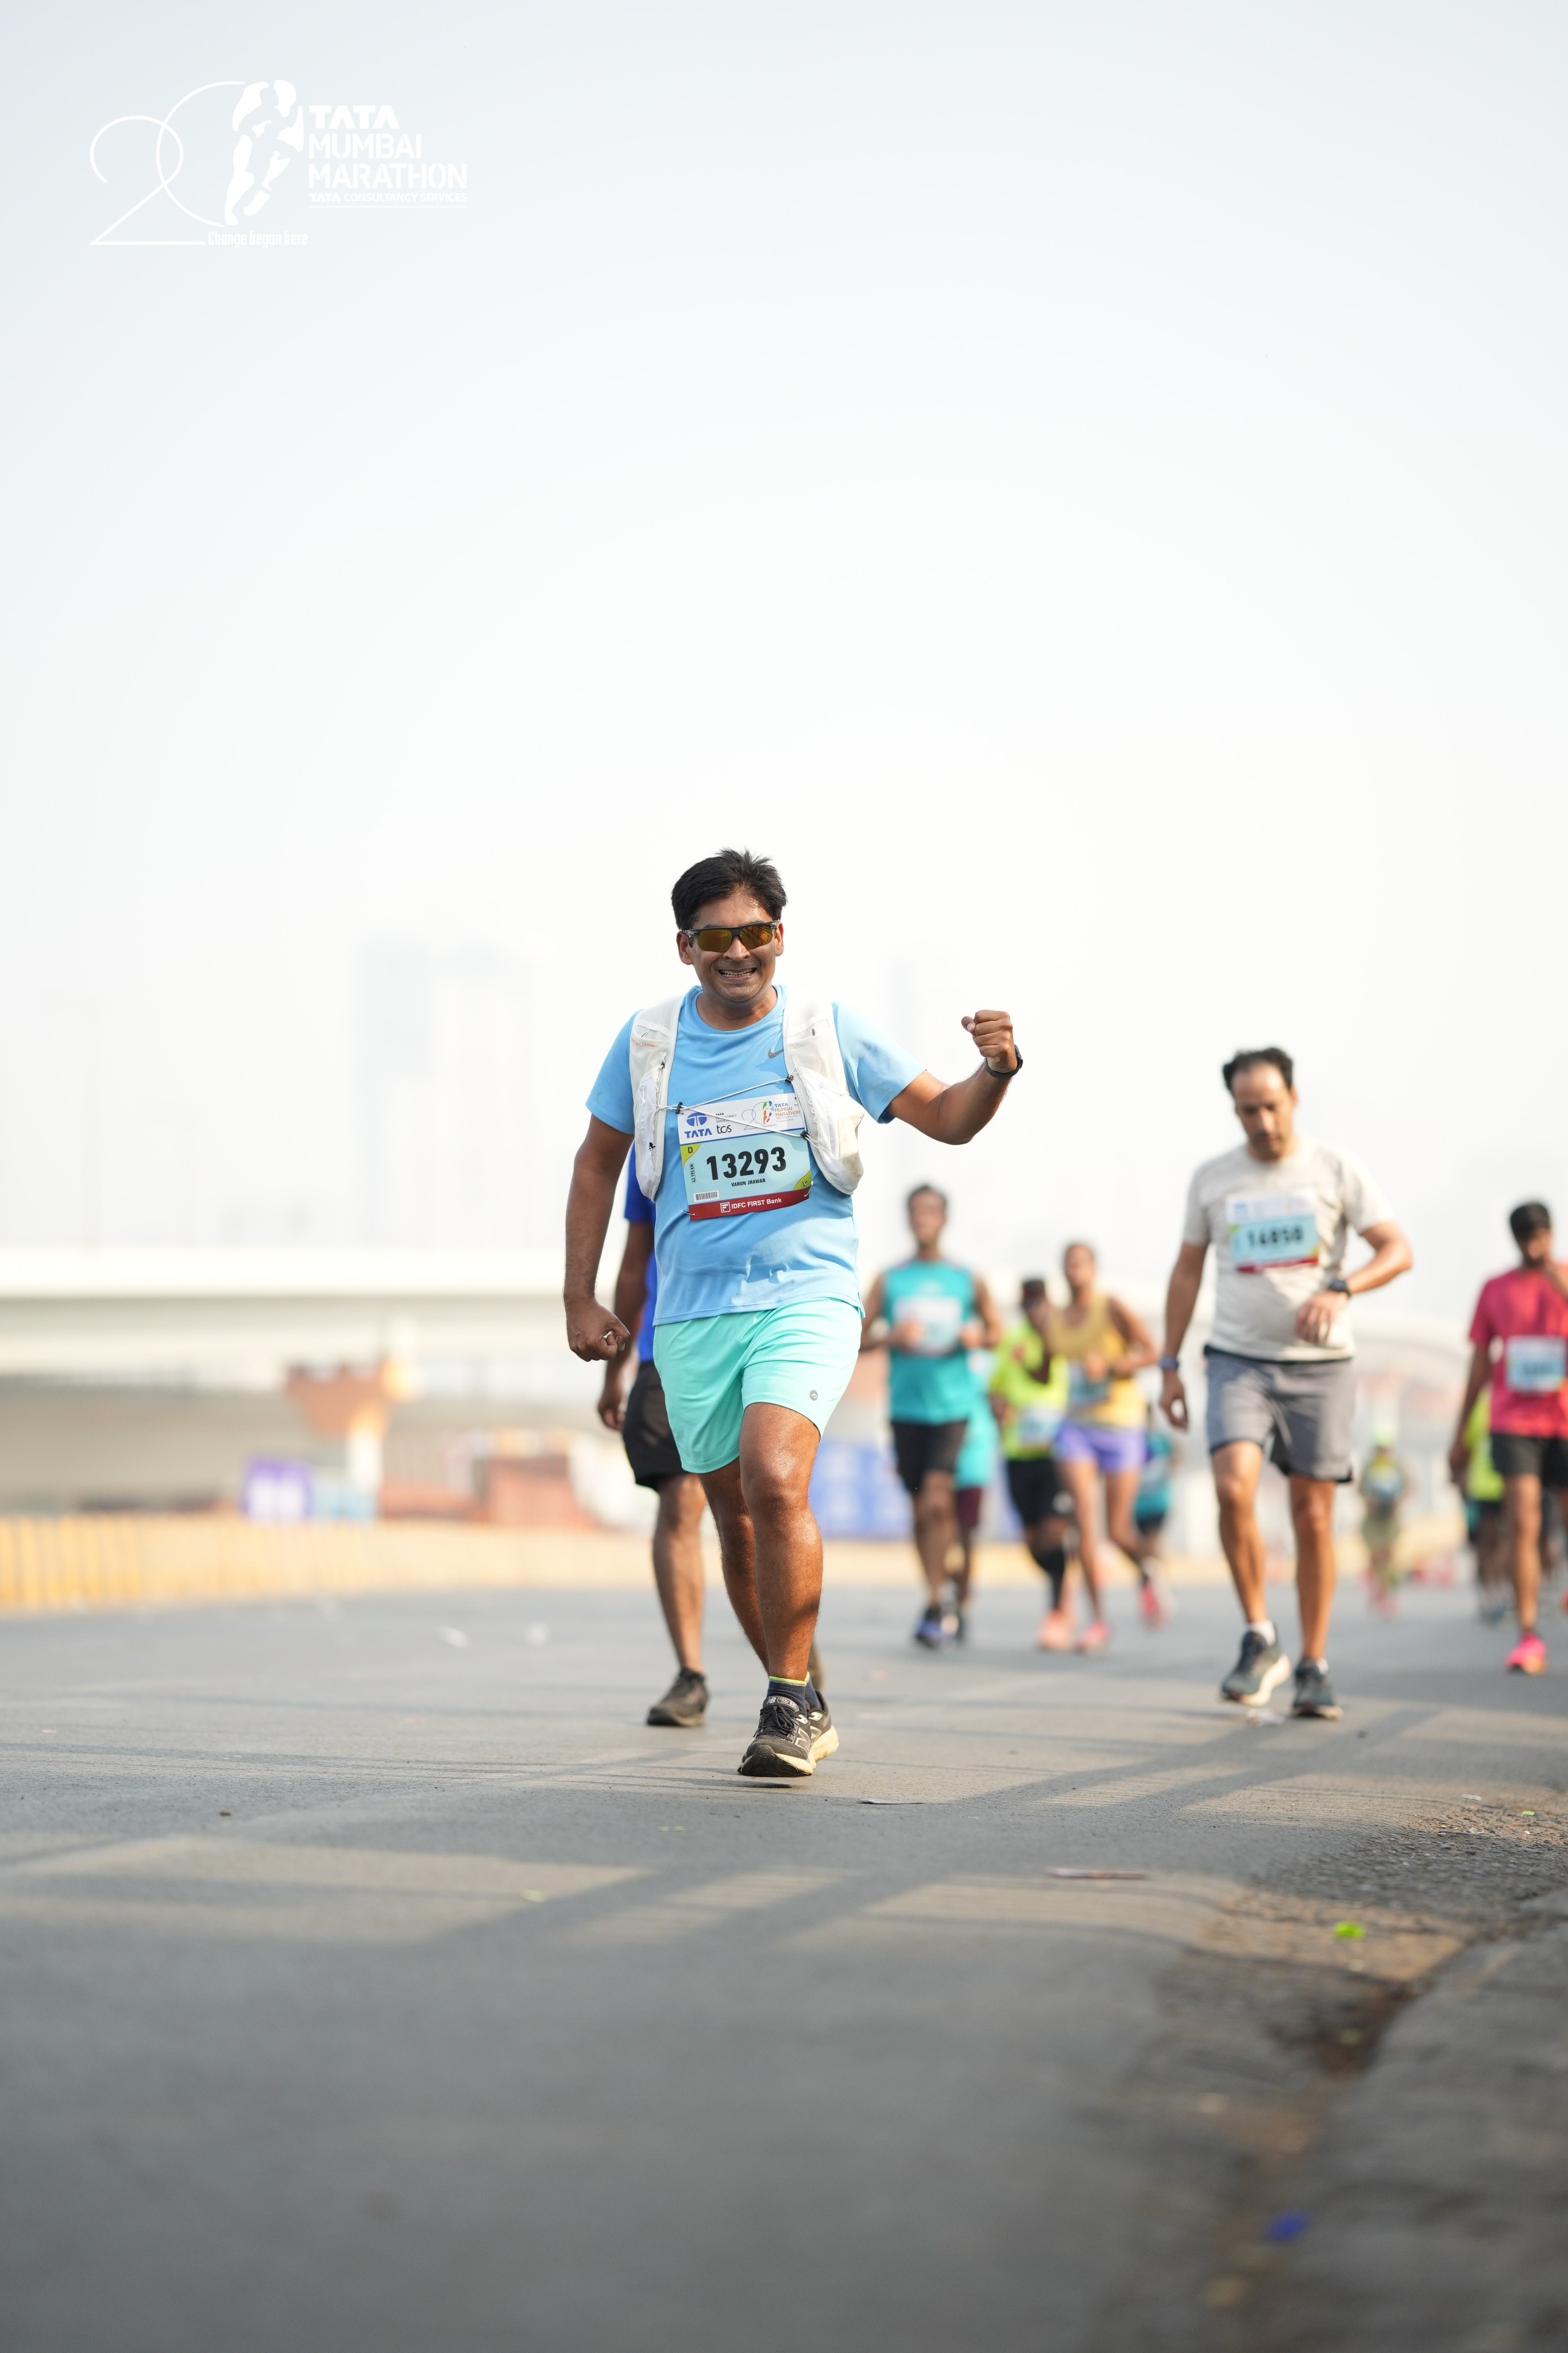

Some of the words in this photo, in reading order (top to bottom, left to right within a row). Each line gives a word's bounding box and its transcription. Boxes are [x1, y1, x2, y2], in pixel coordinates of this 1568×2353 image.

[684, 1128, 713, 1139] TATA
[716, 1125, 732, 1134] tcs
[687, 1146, 693, 1154] D
[706, 1146, 787, 1181] 13293
[747, 1178, 766, 1186] JHAWAR
[747, 1199, 765, 1208] FIRST
[766, 1197, 782, 1205] Bank
